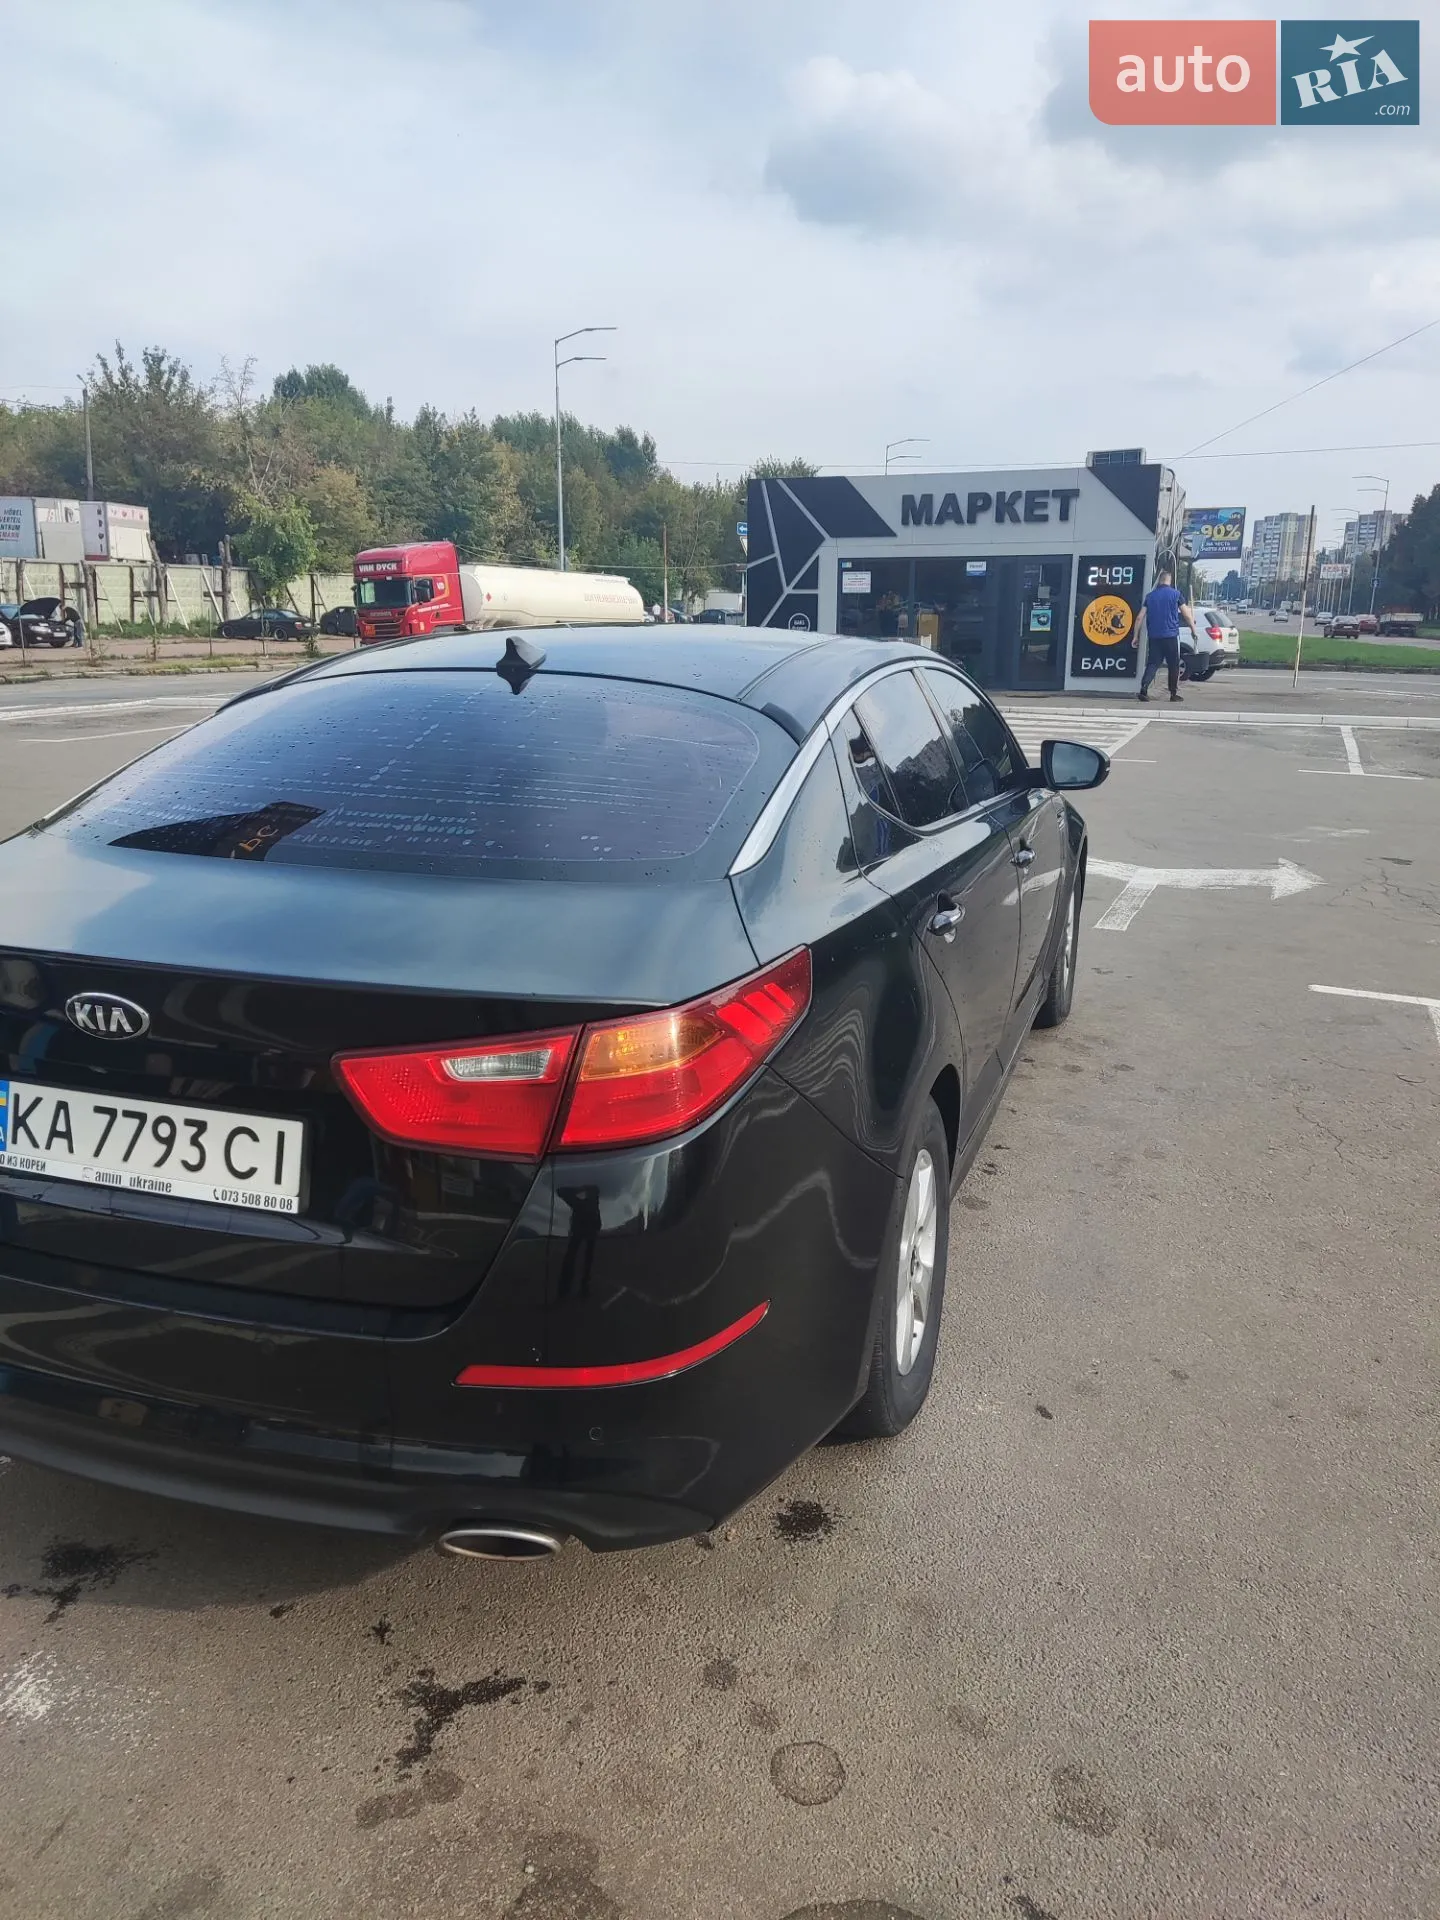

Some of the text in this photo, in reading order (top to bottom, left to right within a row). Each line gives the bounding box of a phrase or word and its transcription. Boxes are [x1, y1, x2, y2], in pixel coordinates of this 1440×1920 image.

[901, 488, 1080, 526] МАРКЕТ
[1087, 566, 1134, 586] 24.99
[1081, 657, 1128, 671] БАРС
[73, 1001, 134, 1033] KIA
[11, 1093, 286, 1186] KA 7793 CI
[221, 1189, 293, 1211] 073 508 80 08
